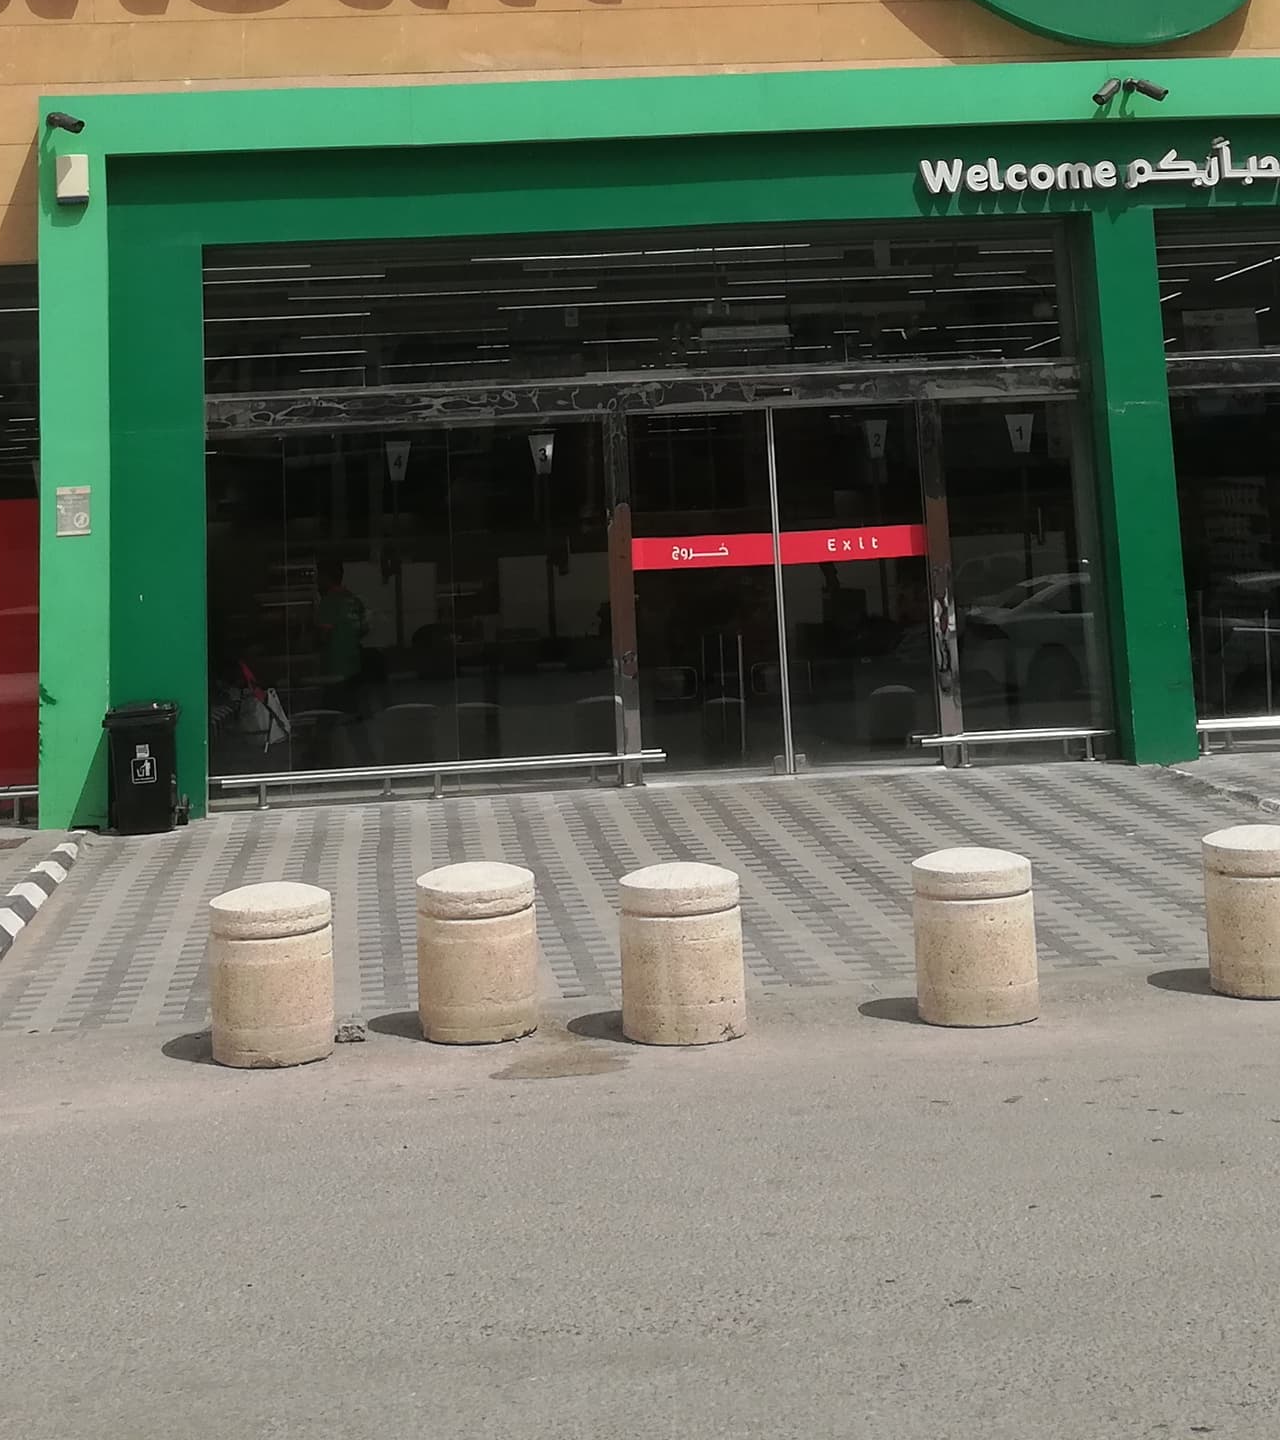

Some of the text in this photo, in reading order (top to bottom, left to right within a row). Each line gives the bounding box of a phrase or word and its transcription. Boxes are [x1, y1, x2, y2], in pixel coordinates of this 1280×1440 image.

[920, 157, 1117, 193] Welcome
[539, 447, 548, 462] 3
[671, 542, 729, 561] خروج
[827, 536, 879, 552] Exit
